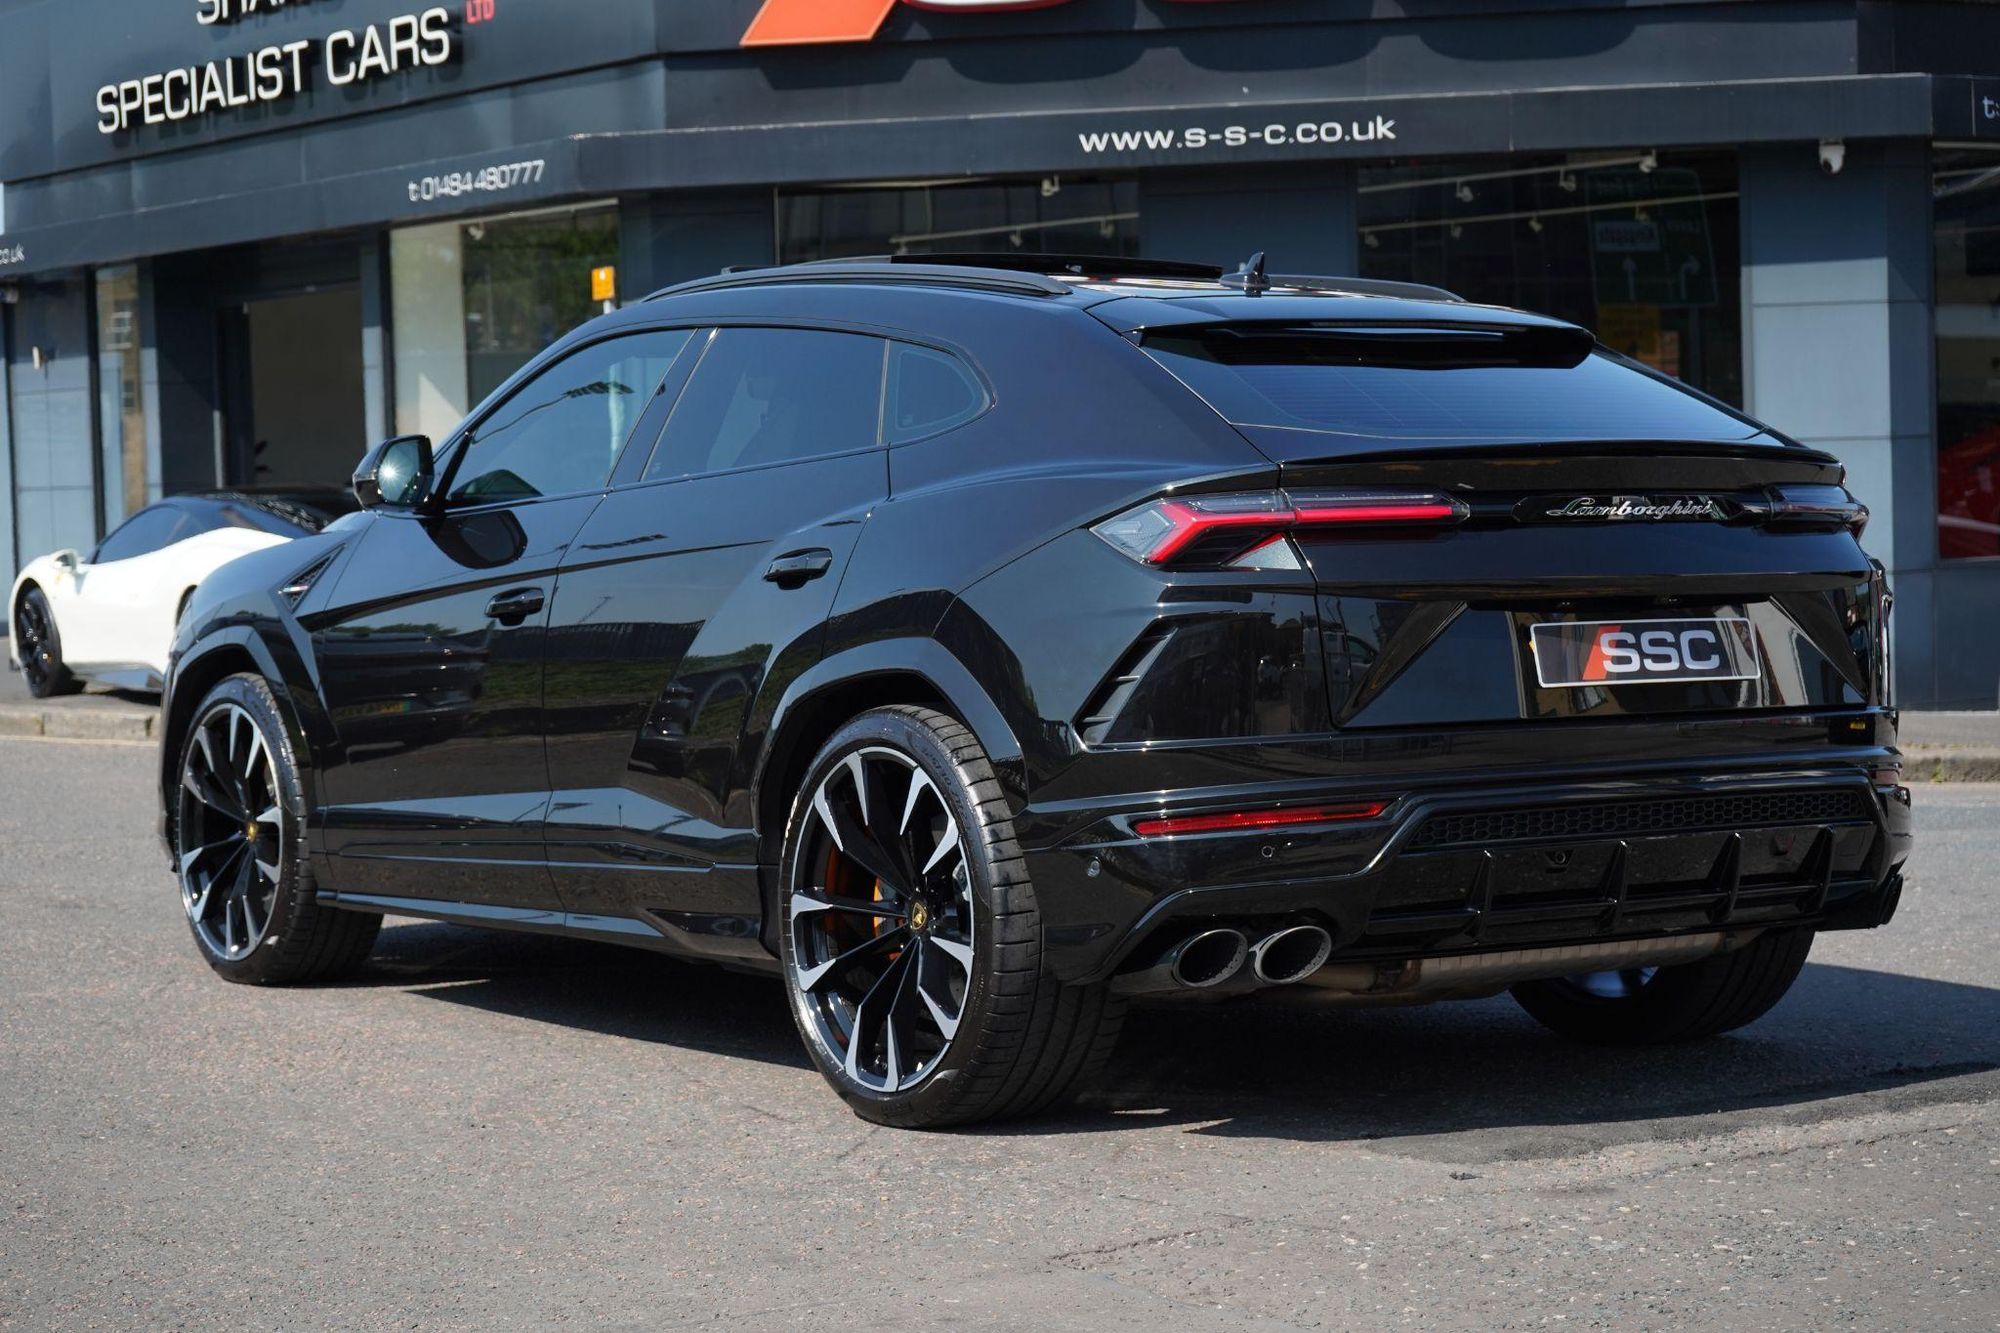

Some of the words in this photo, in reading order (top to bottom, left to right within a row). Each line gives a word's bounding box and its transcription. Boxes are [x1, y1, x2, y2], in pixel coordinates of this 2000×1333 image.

[96, 40, 309, 134] SPECIALIST
[326, 7, 451, 86] CARS
[466, 0, 495, 24] LTD
[1078, 115, 1397, 153] www.s-s-c.co.uk
[1546, 497, 1713, 520] Lamborghini
[1600, 629, 1720, 673] SSC
